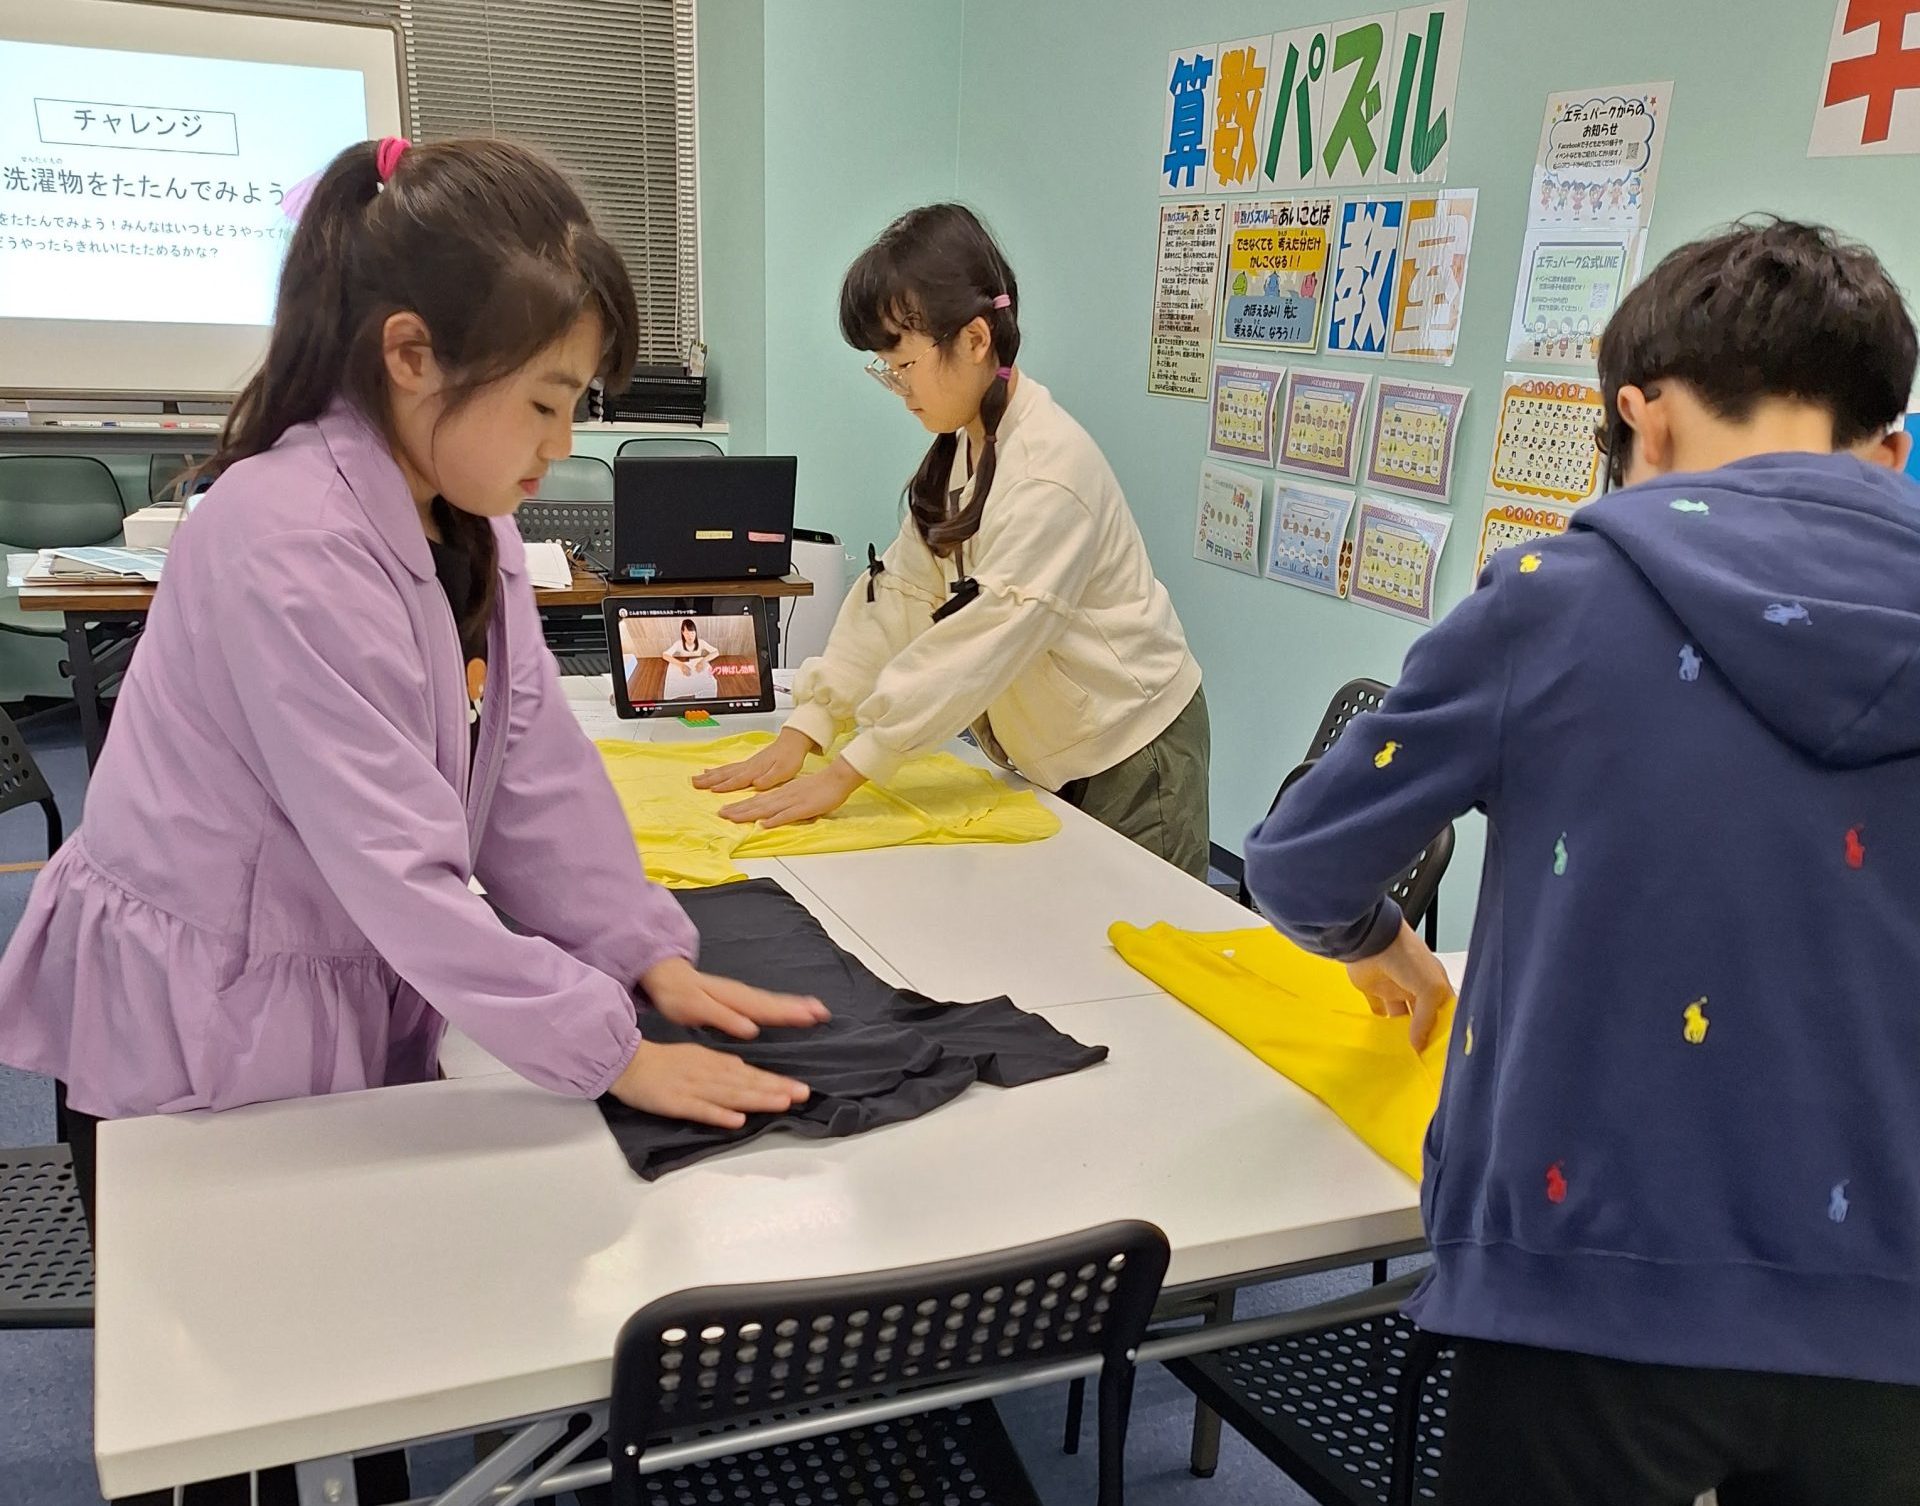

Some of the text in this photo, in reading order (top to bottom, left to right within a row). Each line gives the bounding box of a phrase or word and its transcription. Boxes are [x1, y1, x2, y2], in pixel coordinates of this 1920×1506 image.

[1163, 12, 1447, 188] 算数パズル
[1564, 103, 1645, 122] エデュパークからの
[74, 108, 202, 138] チャレンジ
[1582, 123, 1618, 138] お知らせ
[4, 166, 284, 205] 洗濯物をたたんでみよう
[1192, 207, 1222, 222] おきて
[1278, 205, 1331, 226] あいことば
[1237, 237, 1321, 251] できなくても 考えた分だけ
[1536, 255, 1619, 269] エデュパーク公式LINE
[1335, 202, 1468, 353] 教室
[1243, 304, 1298, 319] おぼえるより 先に
[1234, 324, 1266, 338] 考える人に
